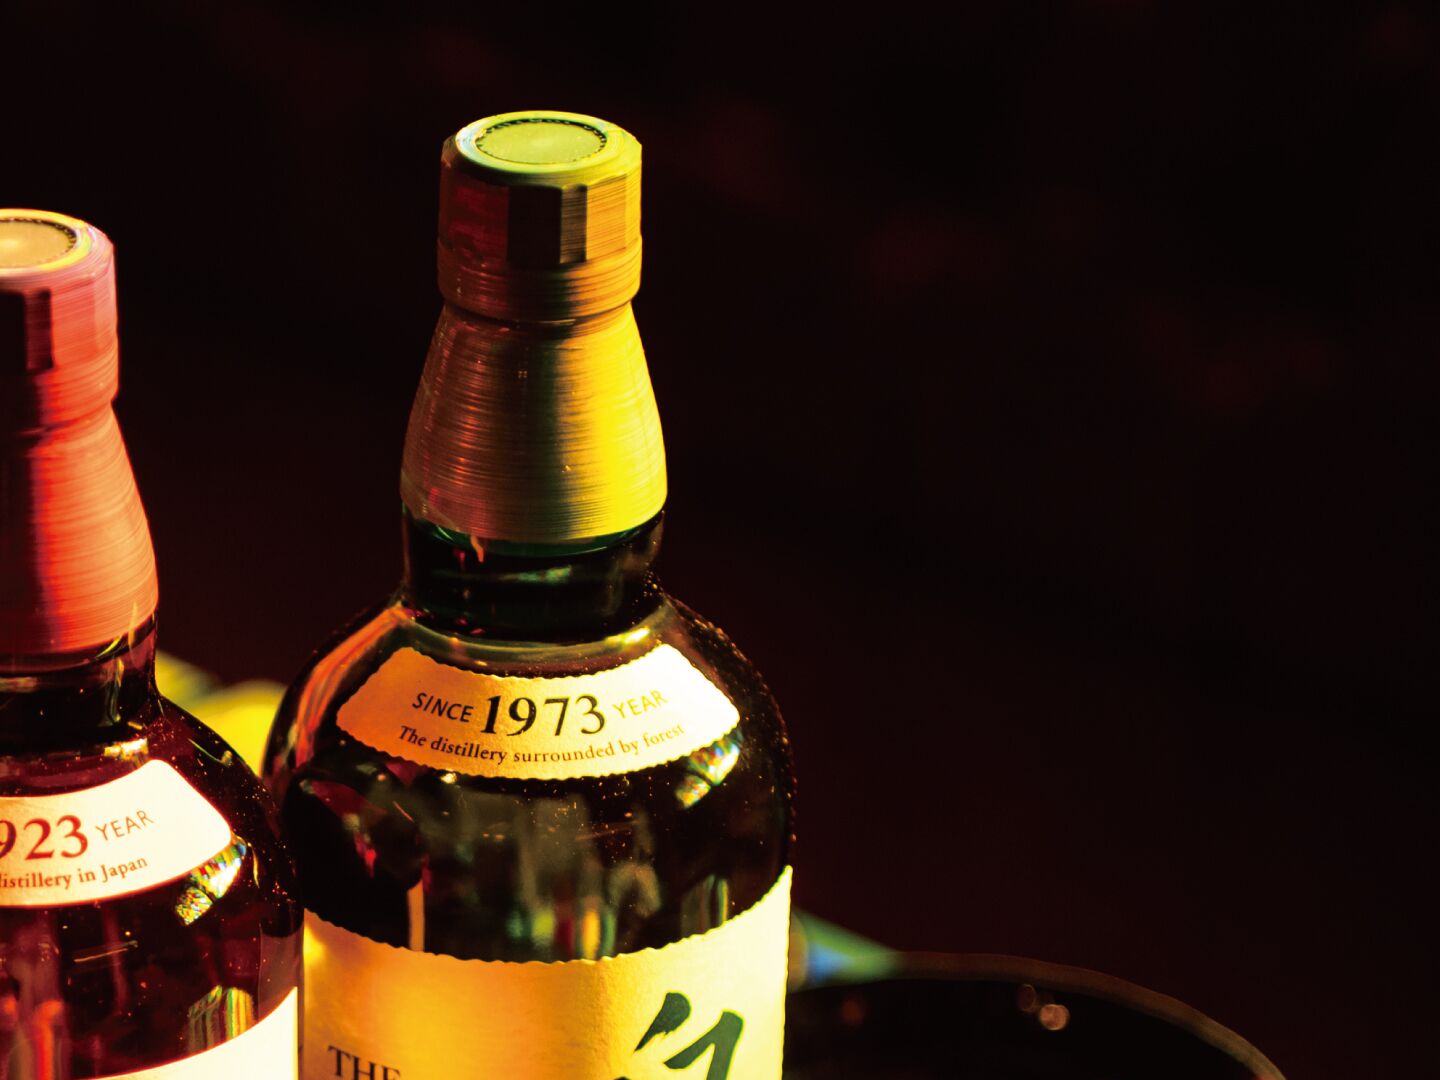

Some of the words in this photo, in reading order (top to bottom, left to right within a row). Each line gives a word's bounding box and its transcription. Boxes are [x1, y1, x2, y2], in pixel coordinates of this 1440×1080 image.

[412, 692, 474, 723] SINCE
[480, 695, 606, 737] 1973
[611, 689, 668, 720] YEAR
[398, 725, 427, 747] The
[431, 735, 507, 765] distillery
[513, 741, 616, 763] surrounded
[619, 736, 640, 756] by
[643, 723, 686, 749] forest
[95, 809, 154, 842] YEAR
[78, 867, 97, 883] in
[102, 855, 148, 883] Japan
